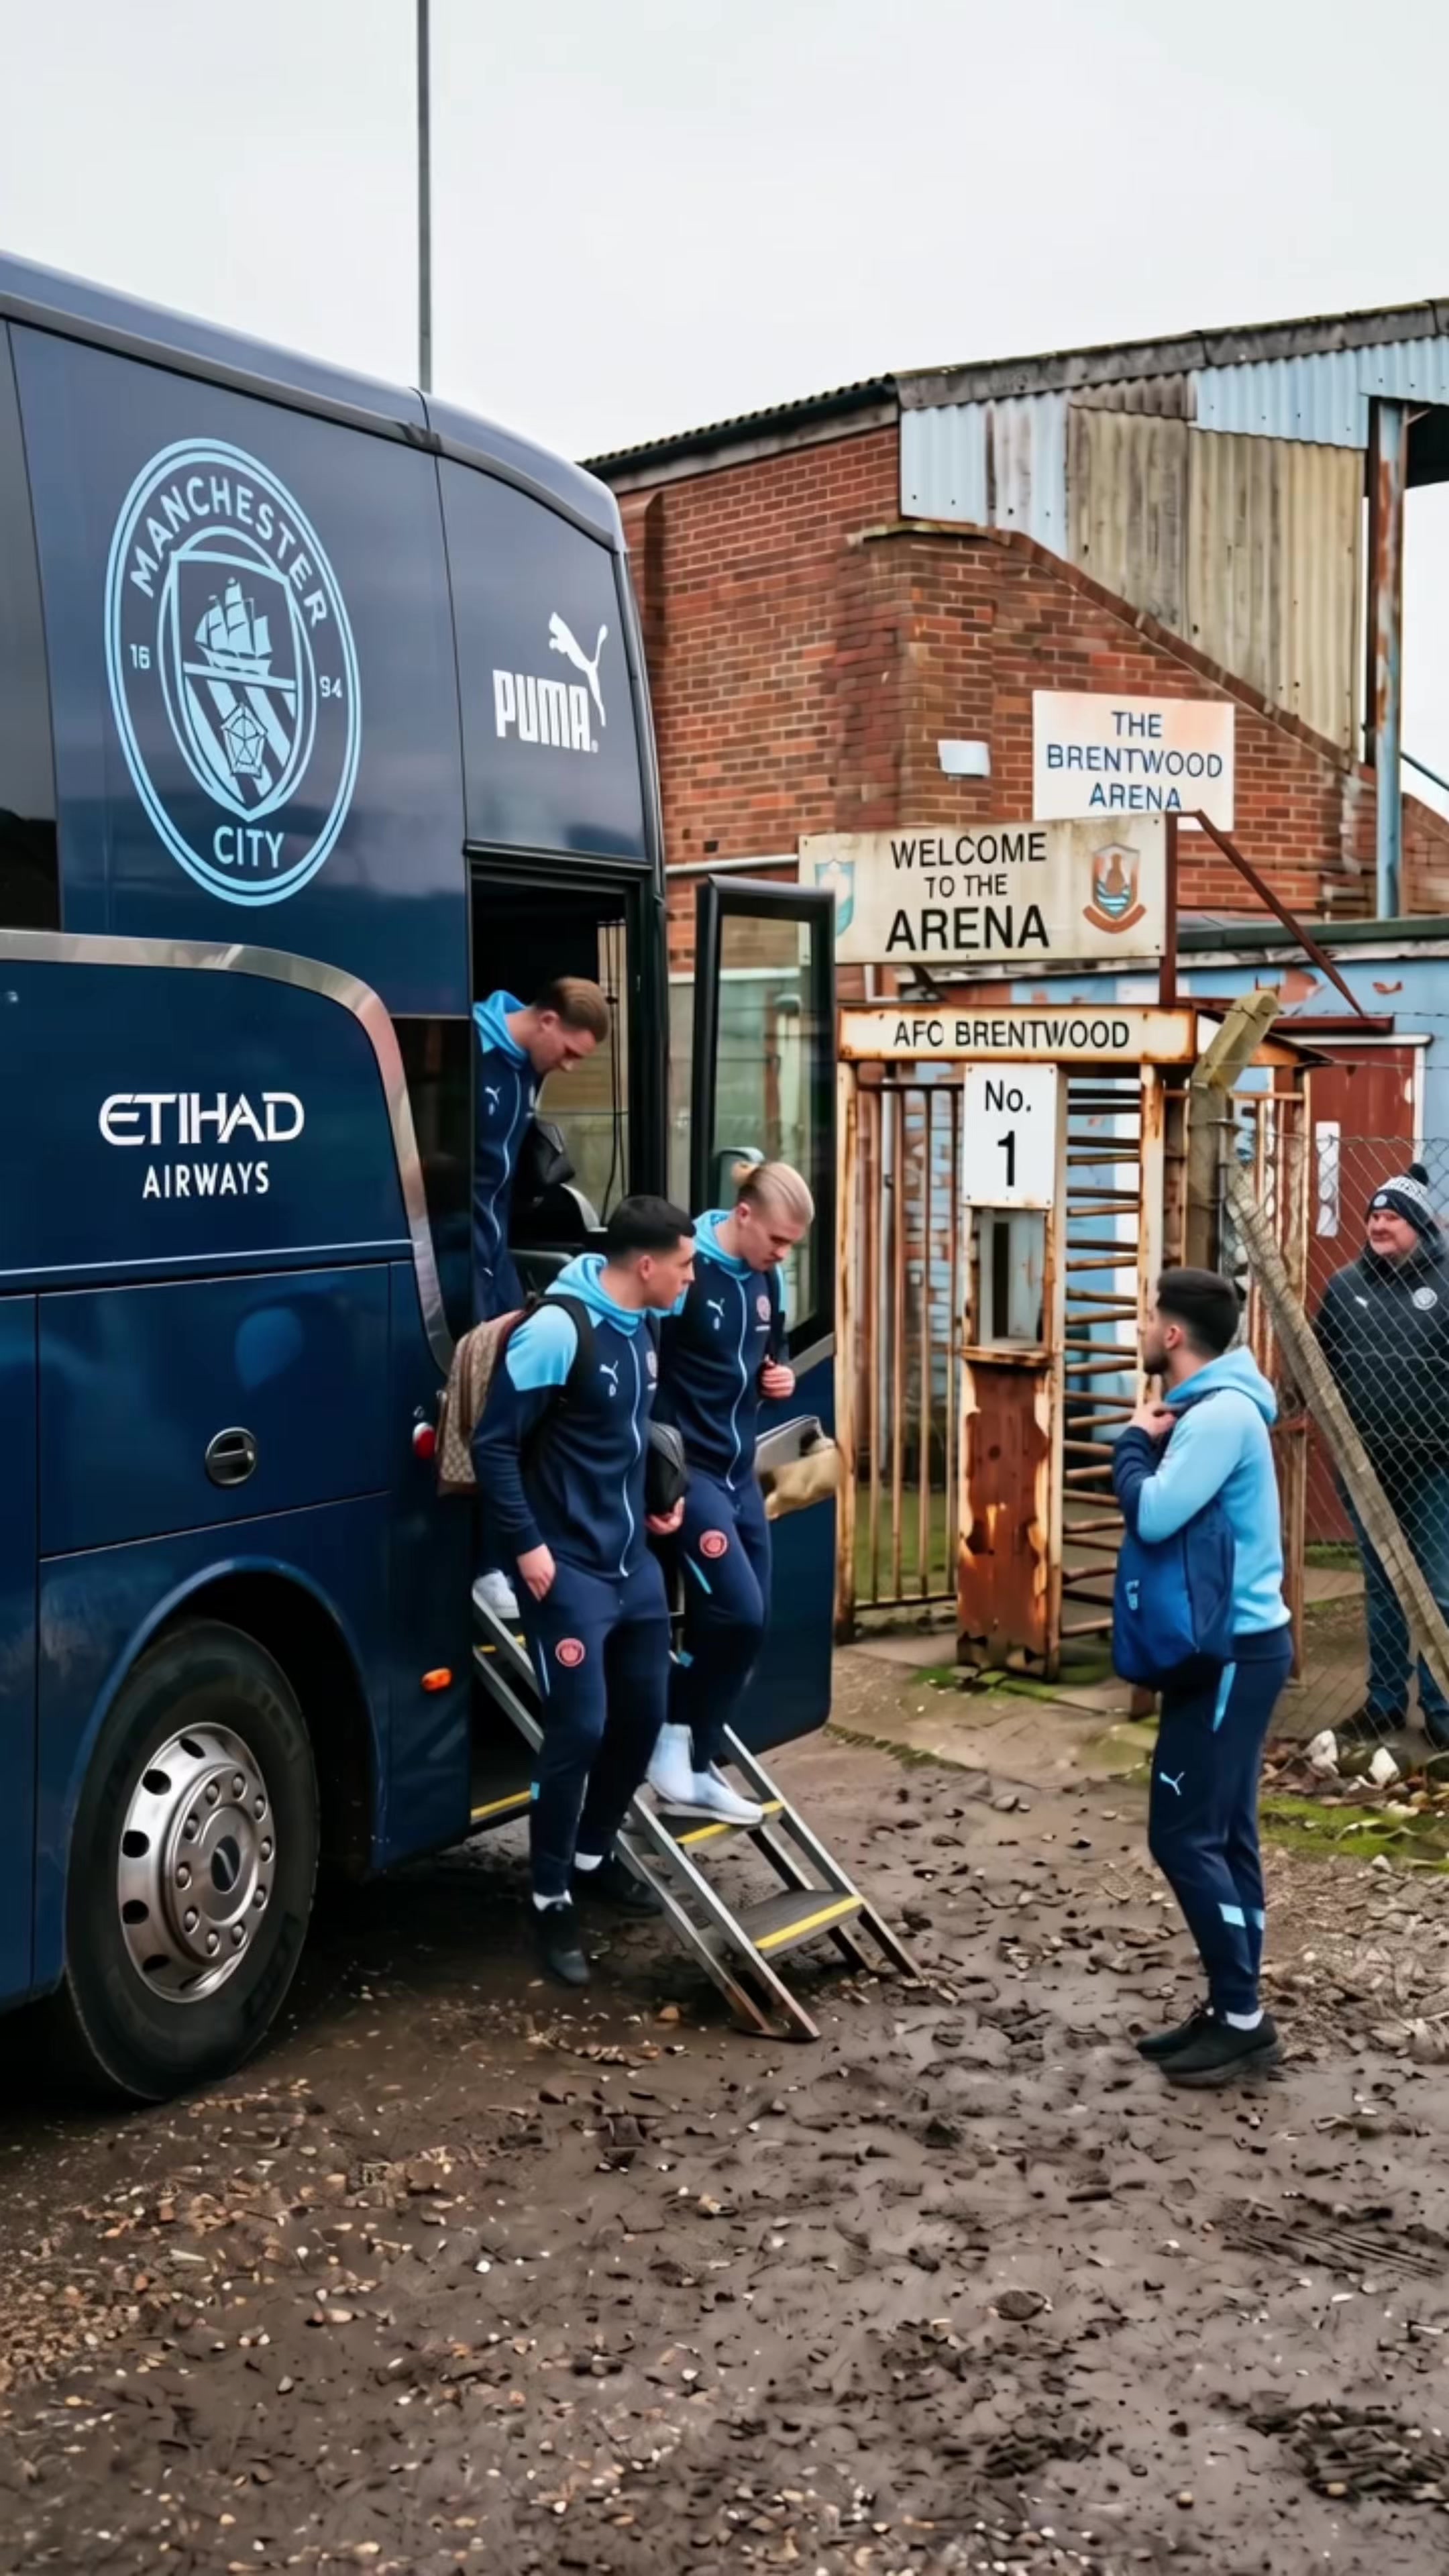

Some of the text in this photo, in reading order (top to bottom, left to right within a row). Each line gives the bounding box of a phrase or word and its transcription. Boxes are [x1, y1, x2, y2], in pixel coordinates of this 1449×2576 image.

[130, 476, 327, 628] MANCHESTER
[130, 644, 150, 669] 16
[319, 676, 343, 698] 94
[493, 669, 591, 752] PUMA
[1112, 711, 1162, 738] THE
[1046, 744, 1223, 778] BRENTWOOD
[1089, 782, 1182, 810] ARENA
[213, 826, 284, 869] CITY
[891, 832, 1047, 869] WELCOME
[924, 873, 1008, 899] TO THE
[885, 904, 1049, 953] ARENA
[894, 1020, 1130, 1048] AFC BRENTWOOD
[985, 1079, 1031, 1112] No.
[99, 1092, 305, 1145] ETIHAD
[997, 1130, 1015, 1187] 1
[142, 1161, 270, 1199] AIRWAYS
